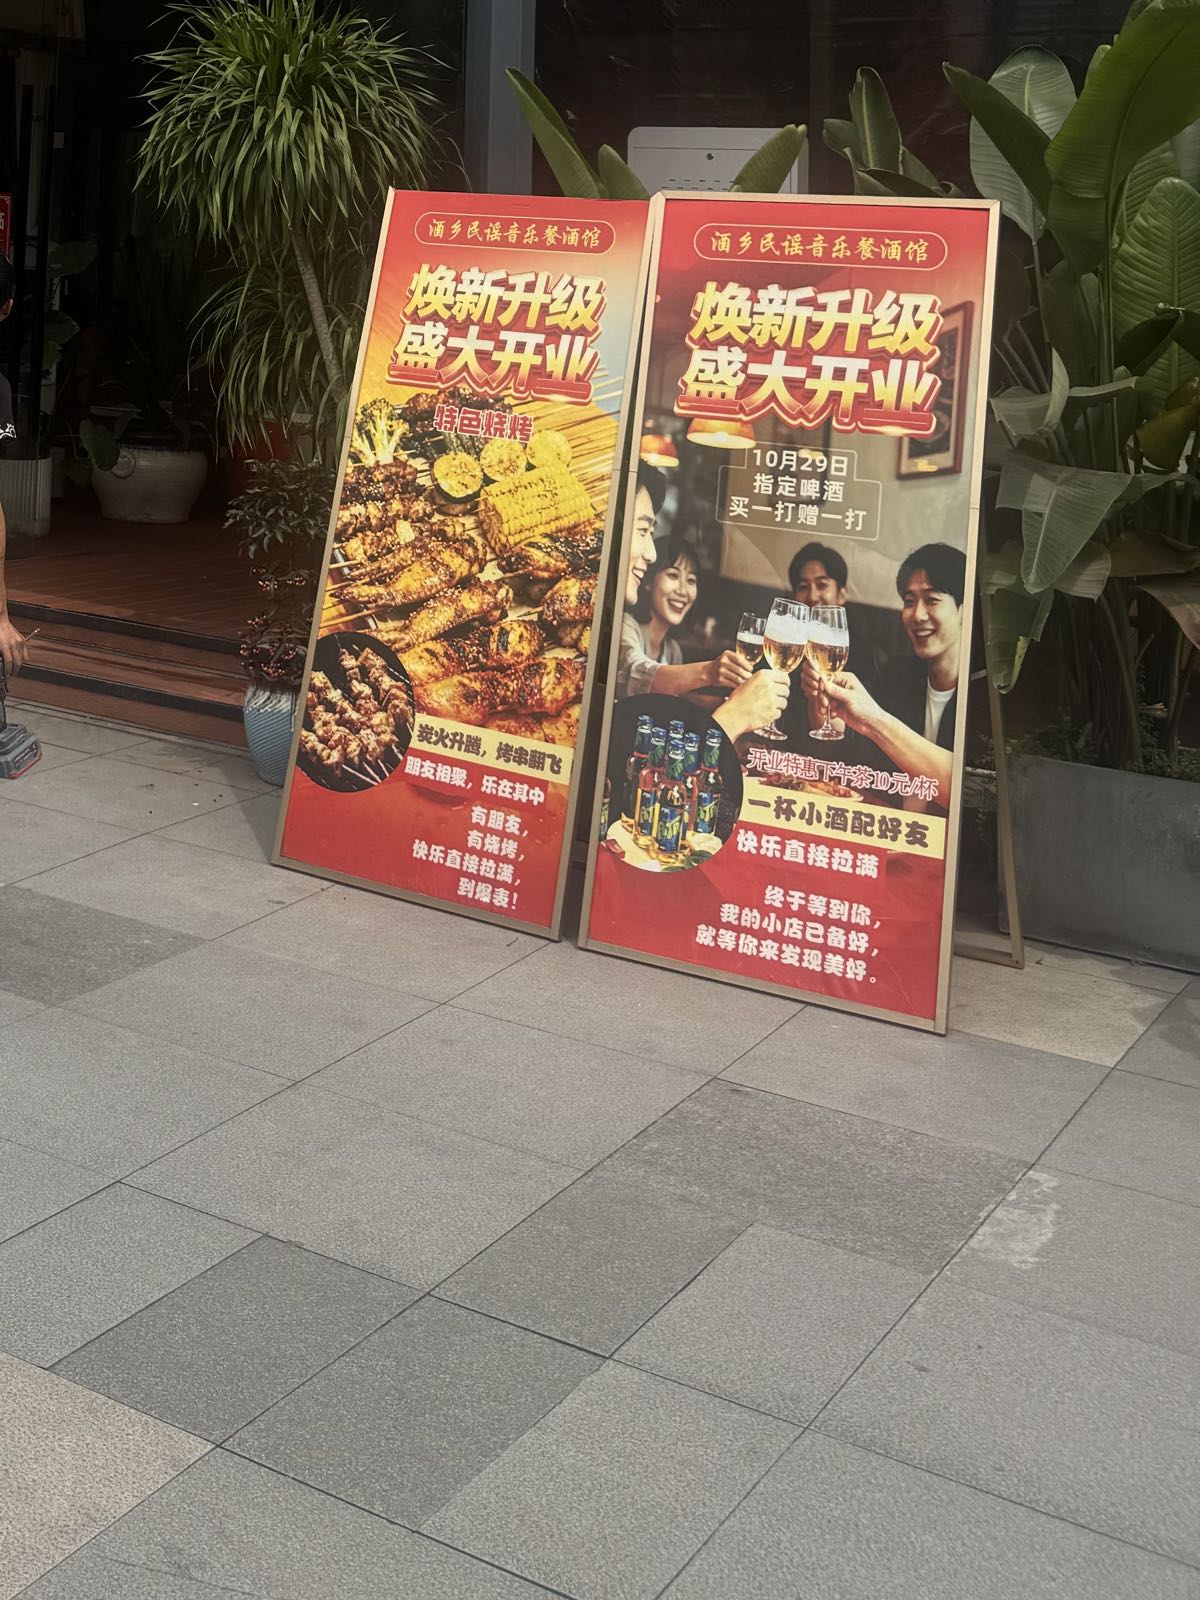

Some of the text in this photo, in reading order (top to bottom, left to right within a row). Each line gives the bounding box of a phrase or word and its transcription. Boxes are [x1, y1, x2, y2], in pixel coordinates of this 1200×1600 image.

[426, 219, 602, 249] 酒乡民谣音乐餐酒馆
[708, 231, 930, 263] 酒乡民谣音乐餐酒馆
[402, 262, 605, 333] 焕新升级
[688, 280, 939, 357] 焕新升级
[388, 318, 597, 397] 盛大开业
[677, 343, 935, 428] 盛大开业
[432, 404, 534, 442] 特色烧烤
[751, 447, 848, 475] 10月29日
[753, 472, 845, 502] 指定啤酒
[728, 495, 867, 531] 买一打赠一打
[746, 746, 939, 803] 开业特惠下午茶10元/杯
[746, 790, 930, 848] 一杯小酒配好友
[735, 828, 879, 879] 快乐直接拉满
[719, 902, 880, 957] 我的小店已备好，
[764, 884, 882, 930] 终于等到你，
[695, 922, 877, 985] 就等你来发现美好。
